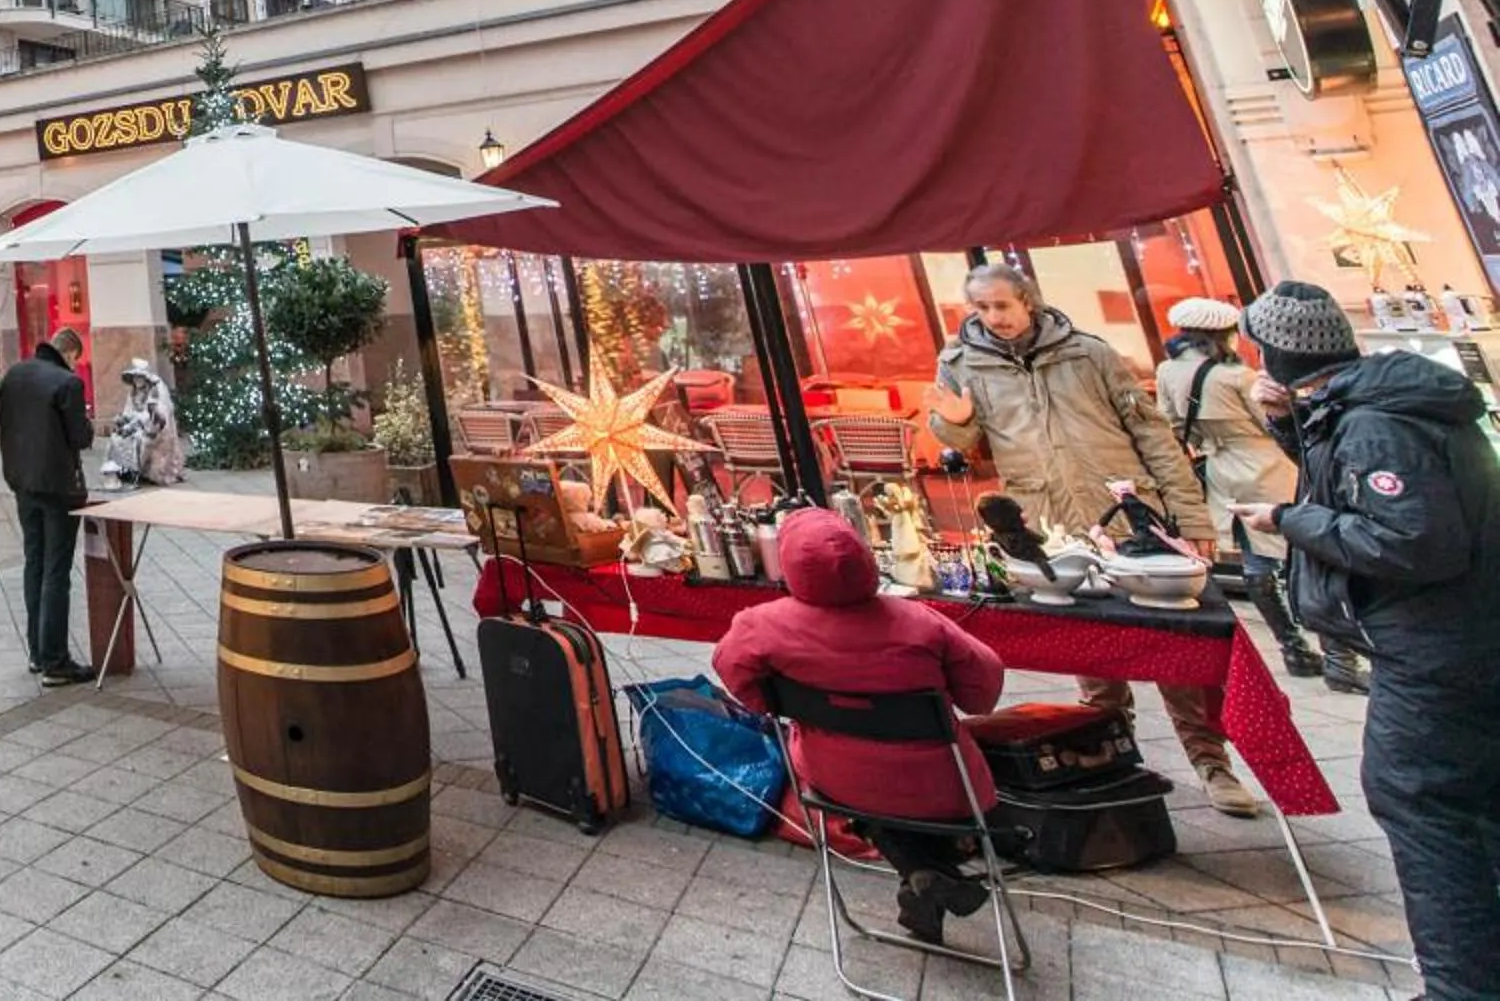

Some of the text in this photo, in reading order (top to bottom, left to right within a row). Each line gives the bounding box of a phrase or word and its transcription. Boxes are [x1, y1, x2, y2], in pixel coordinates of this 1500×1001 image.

[1409, 52, 1467, 99] RICARD
[43, 72, 357, 154] GOZSDU DVAR
